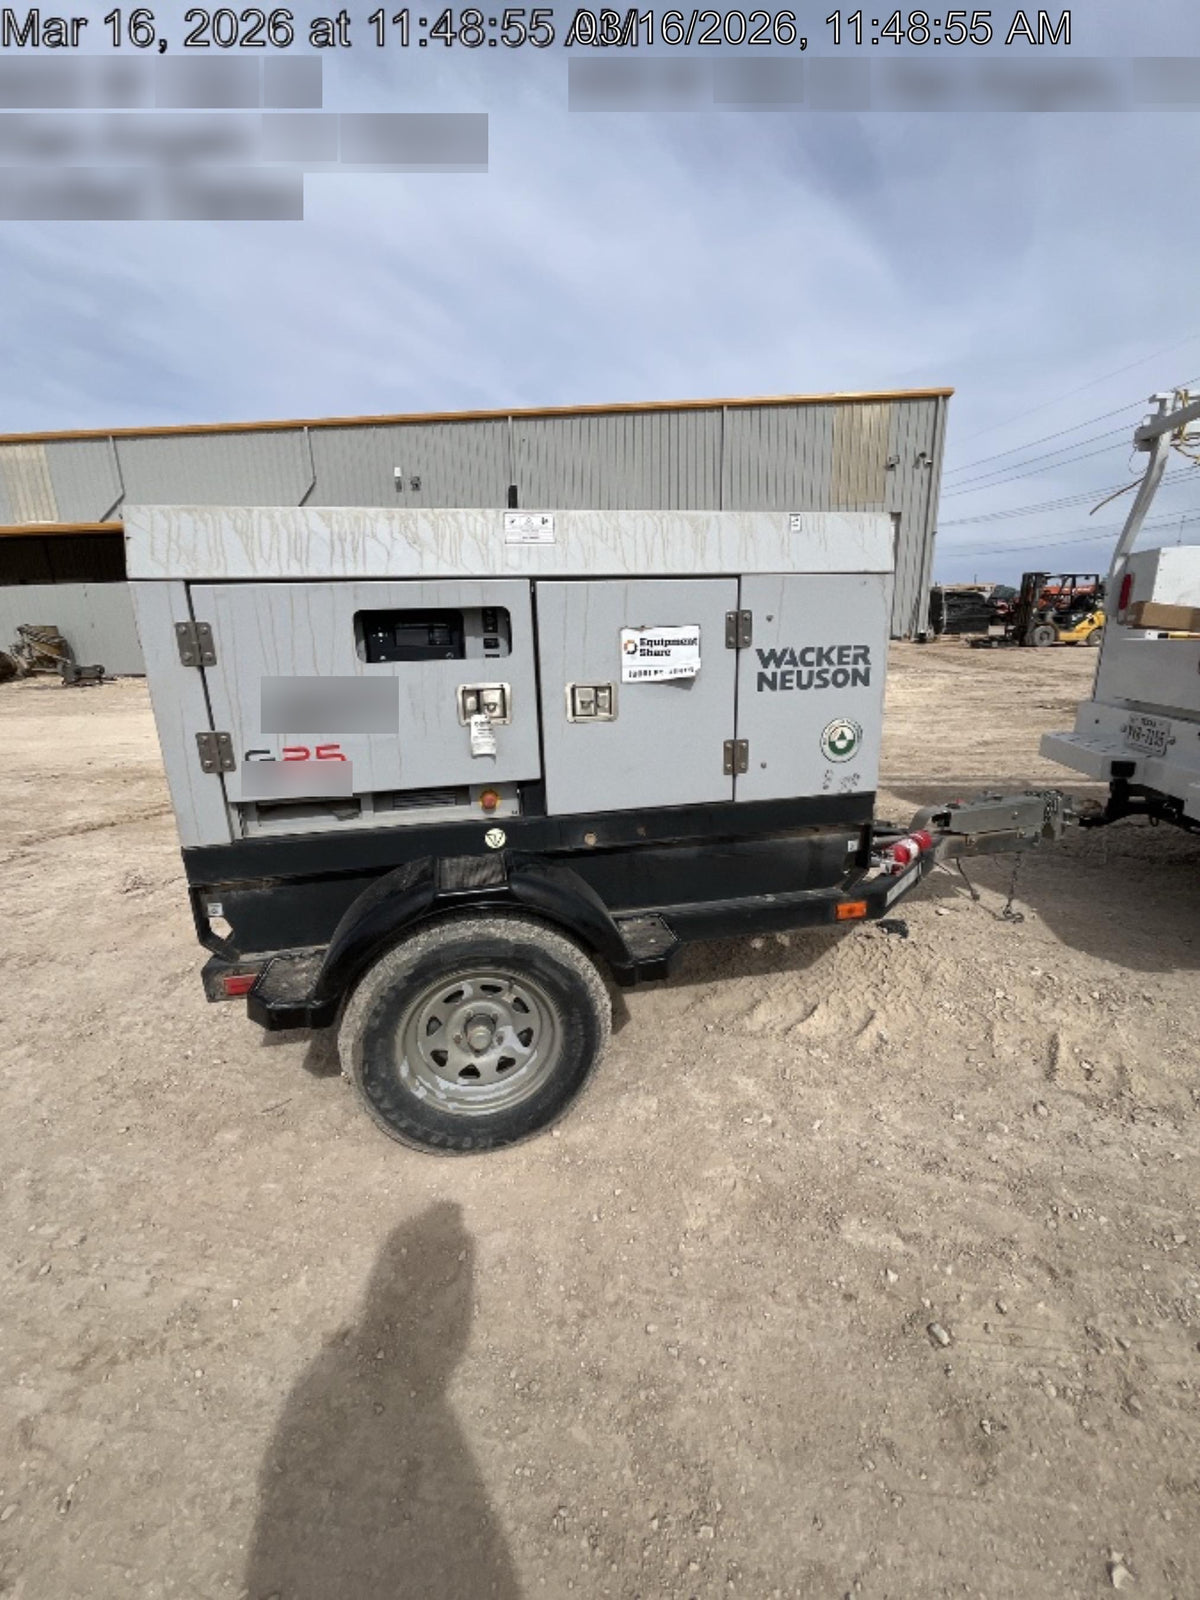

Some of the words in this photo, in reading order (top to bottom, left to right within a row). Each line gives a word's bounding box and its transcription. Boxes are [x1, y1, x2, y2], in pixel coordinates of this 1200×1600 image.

[639, 648, 671, 657] Share
[755, 645, 872, 669] WACKER
[756, 666, 871, 692] NEUSON
